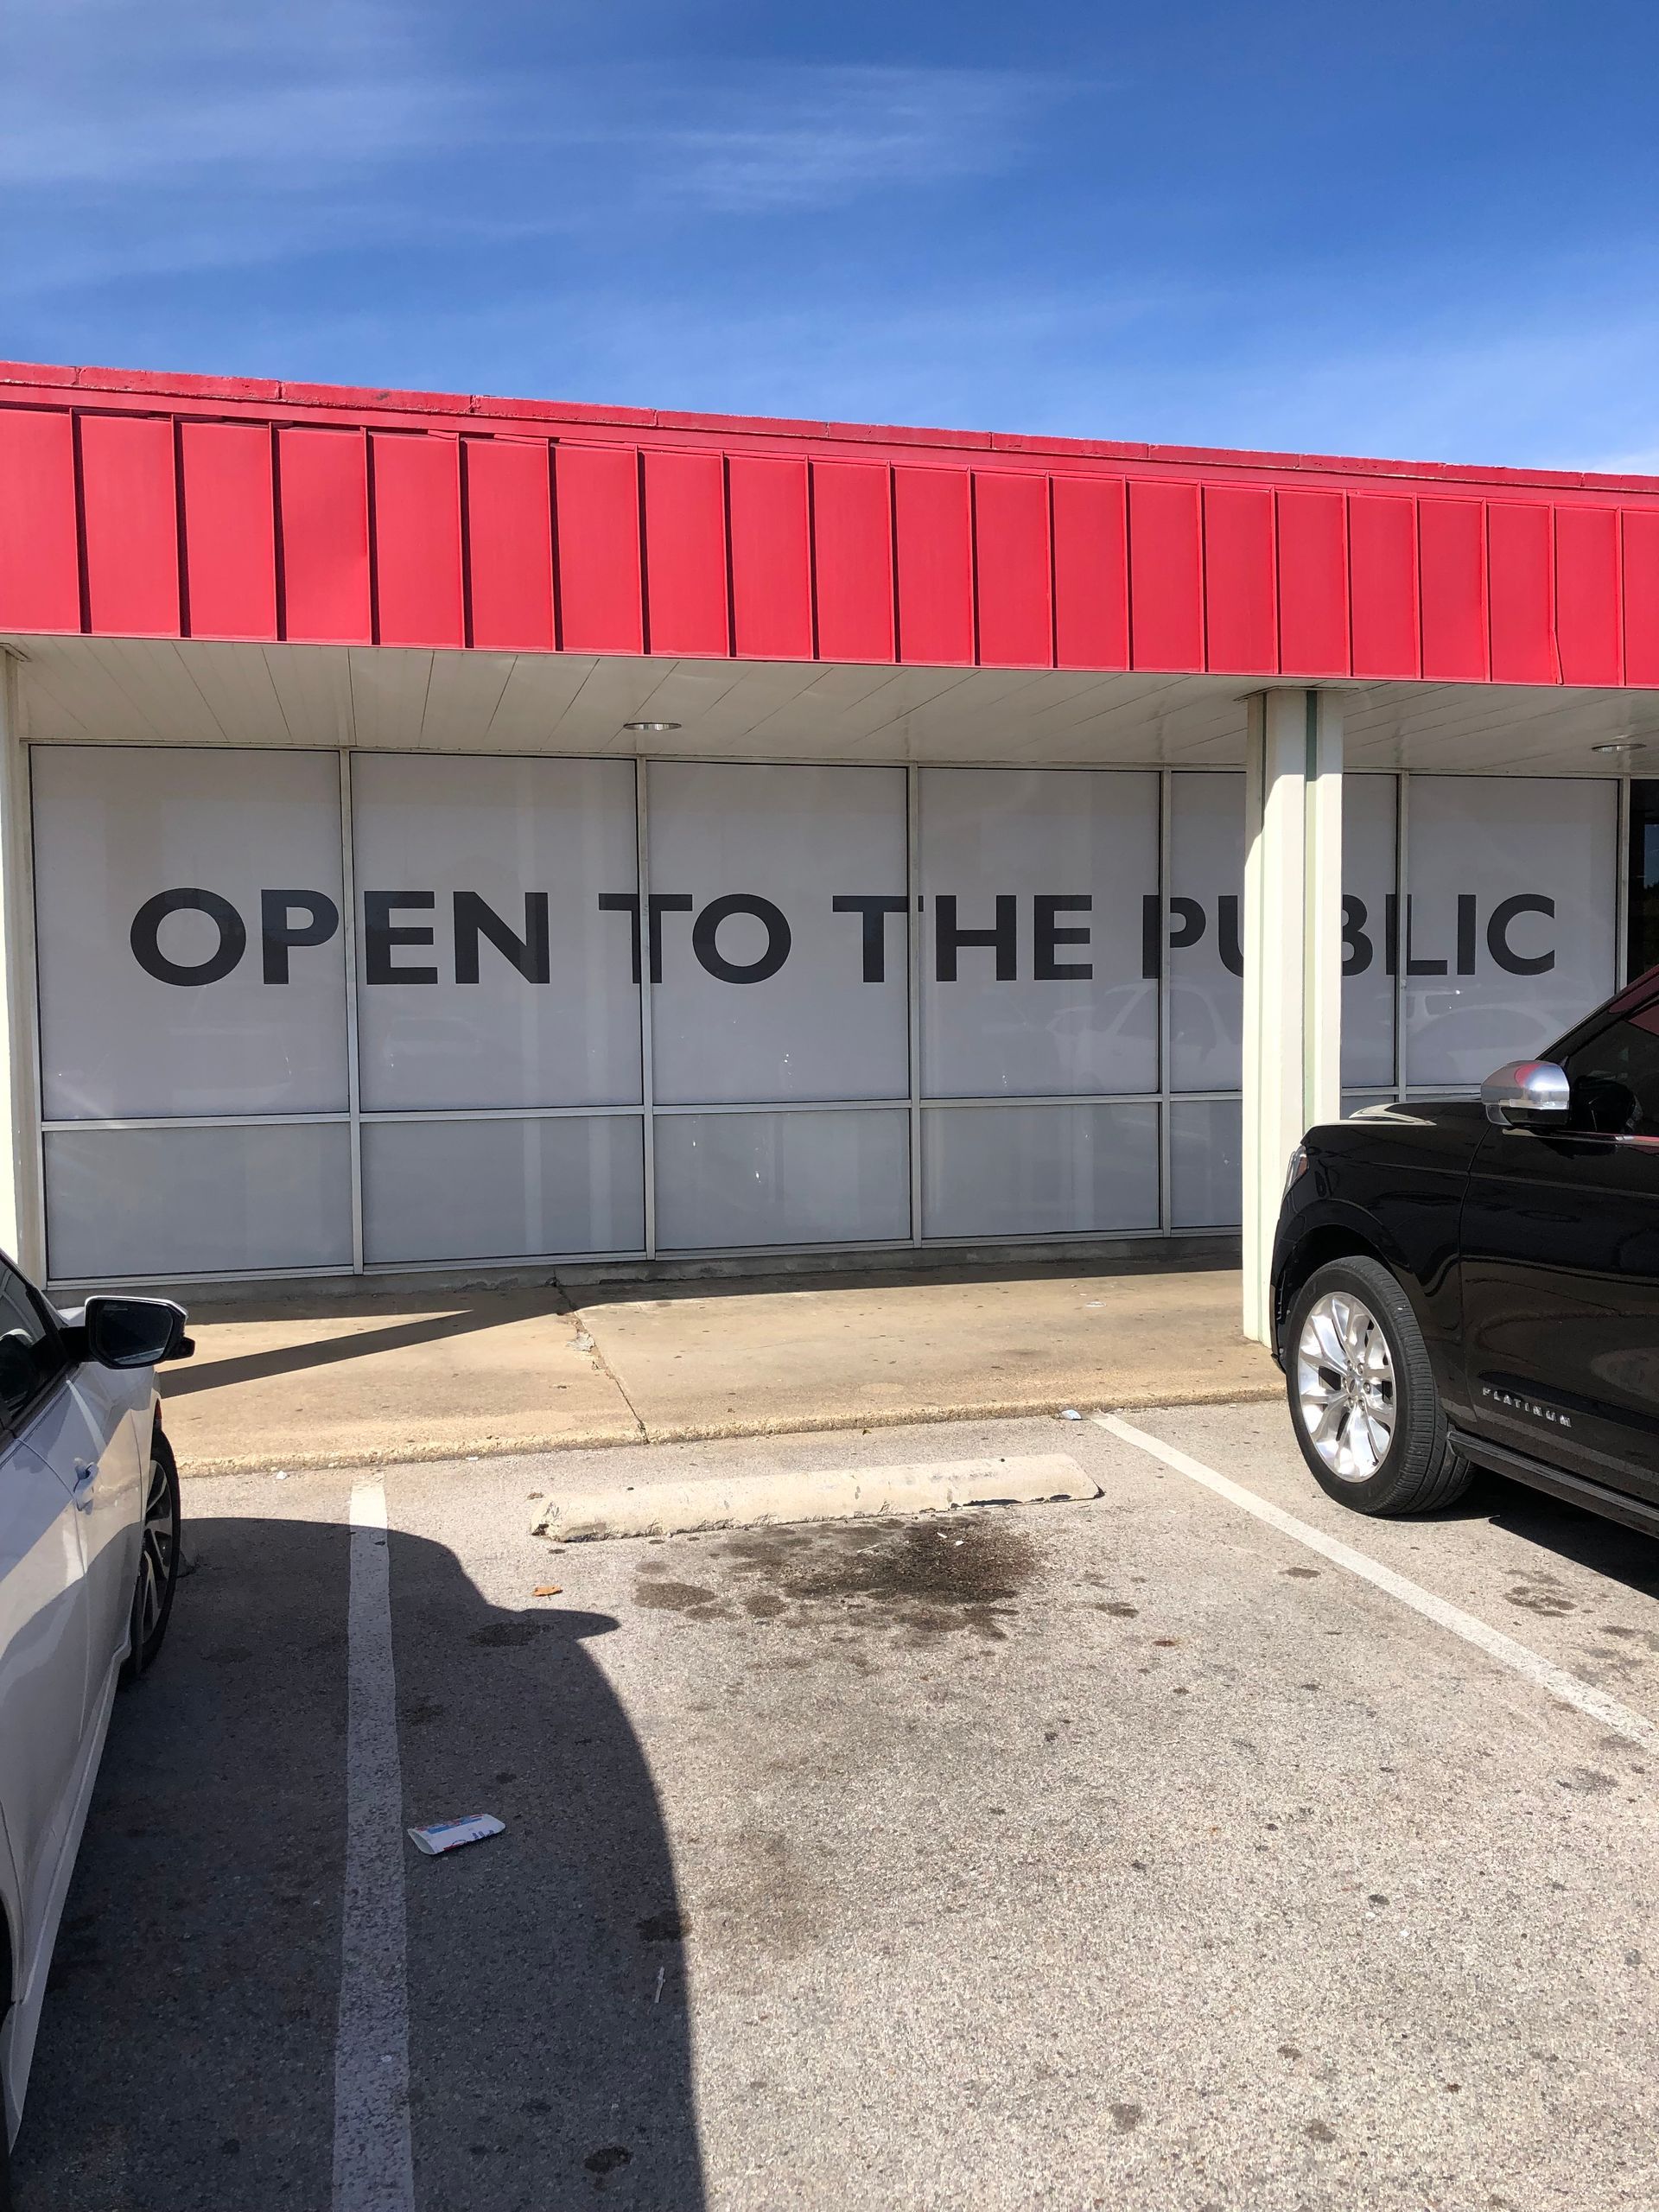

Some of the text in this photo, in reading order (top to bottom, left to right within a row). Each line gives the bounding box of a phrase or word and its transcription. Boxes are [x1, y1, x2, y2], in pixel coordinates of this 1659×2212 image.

[130, 887, 550, 987] OPEN
[598, 893, 792, 984] TO
[832, 894, 1093, 983] THE
[1482, 1387, 1572, 1427] PLATINUM
